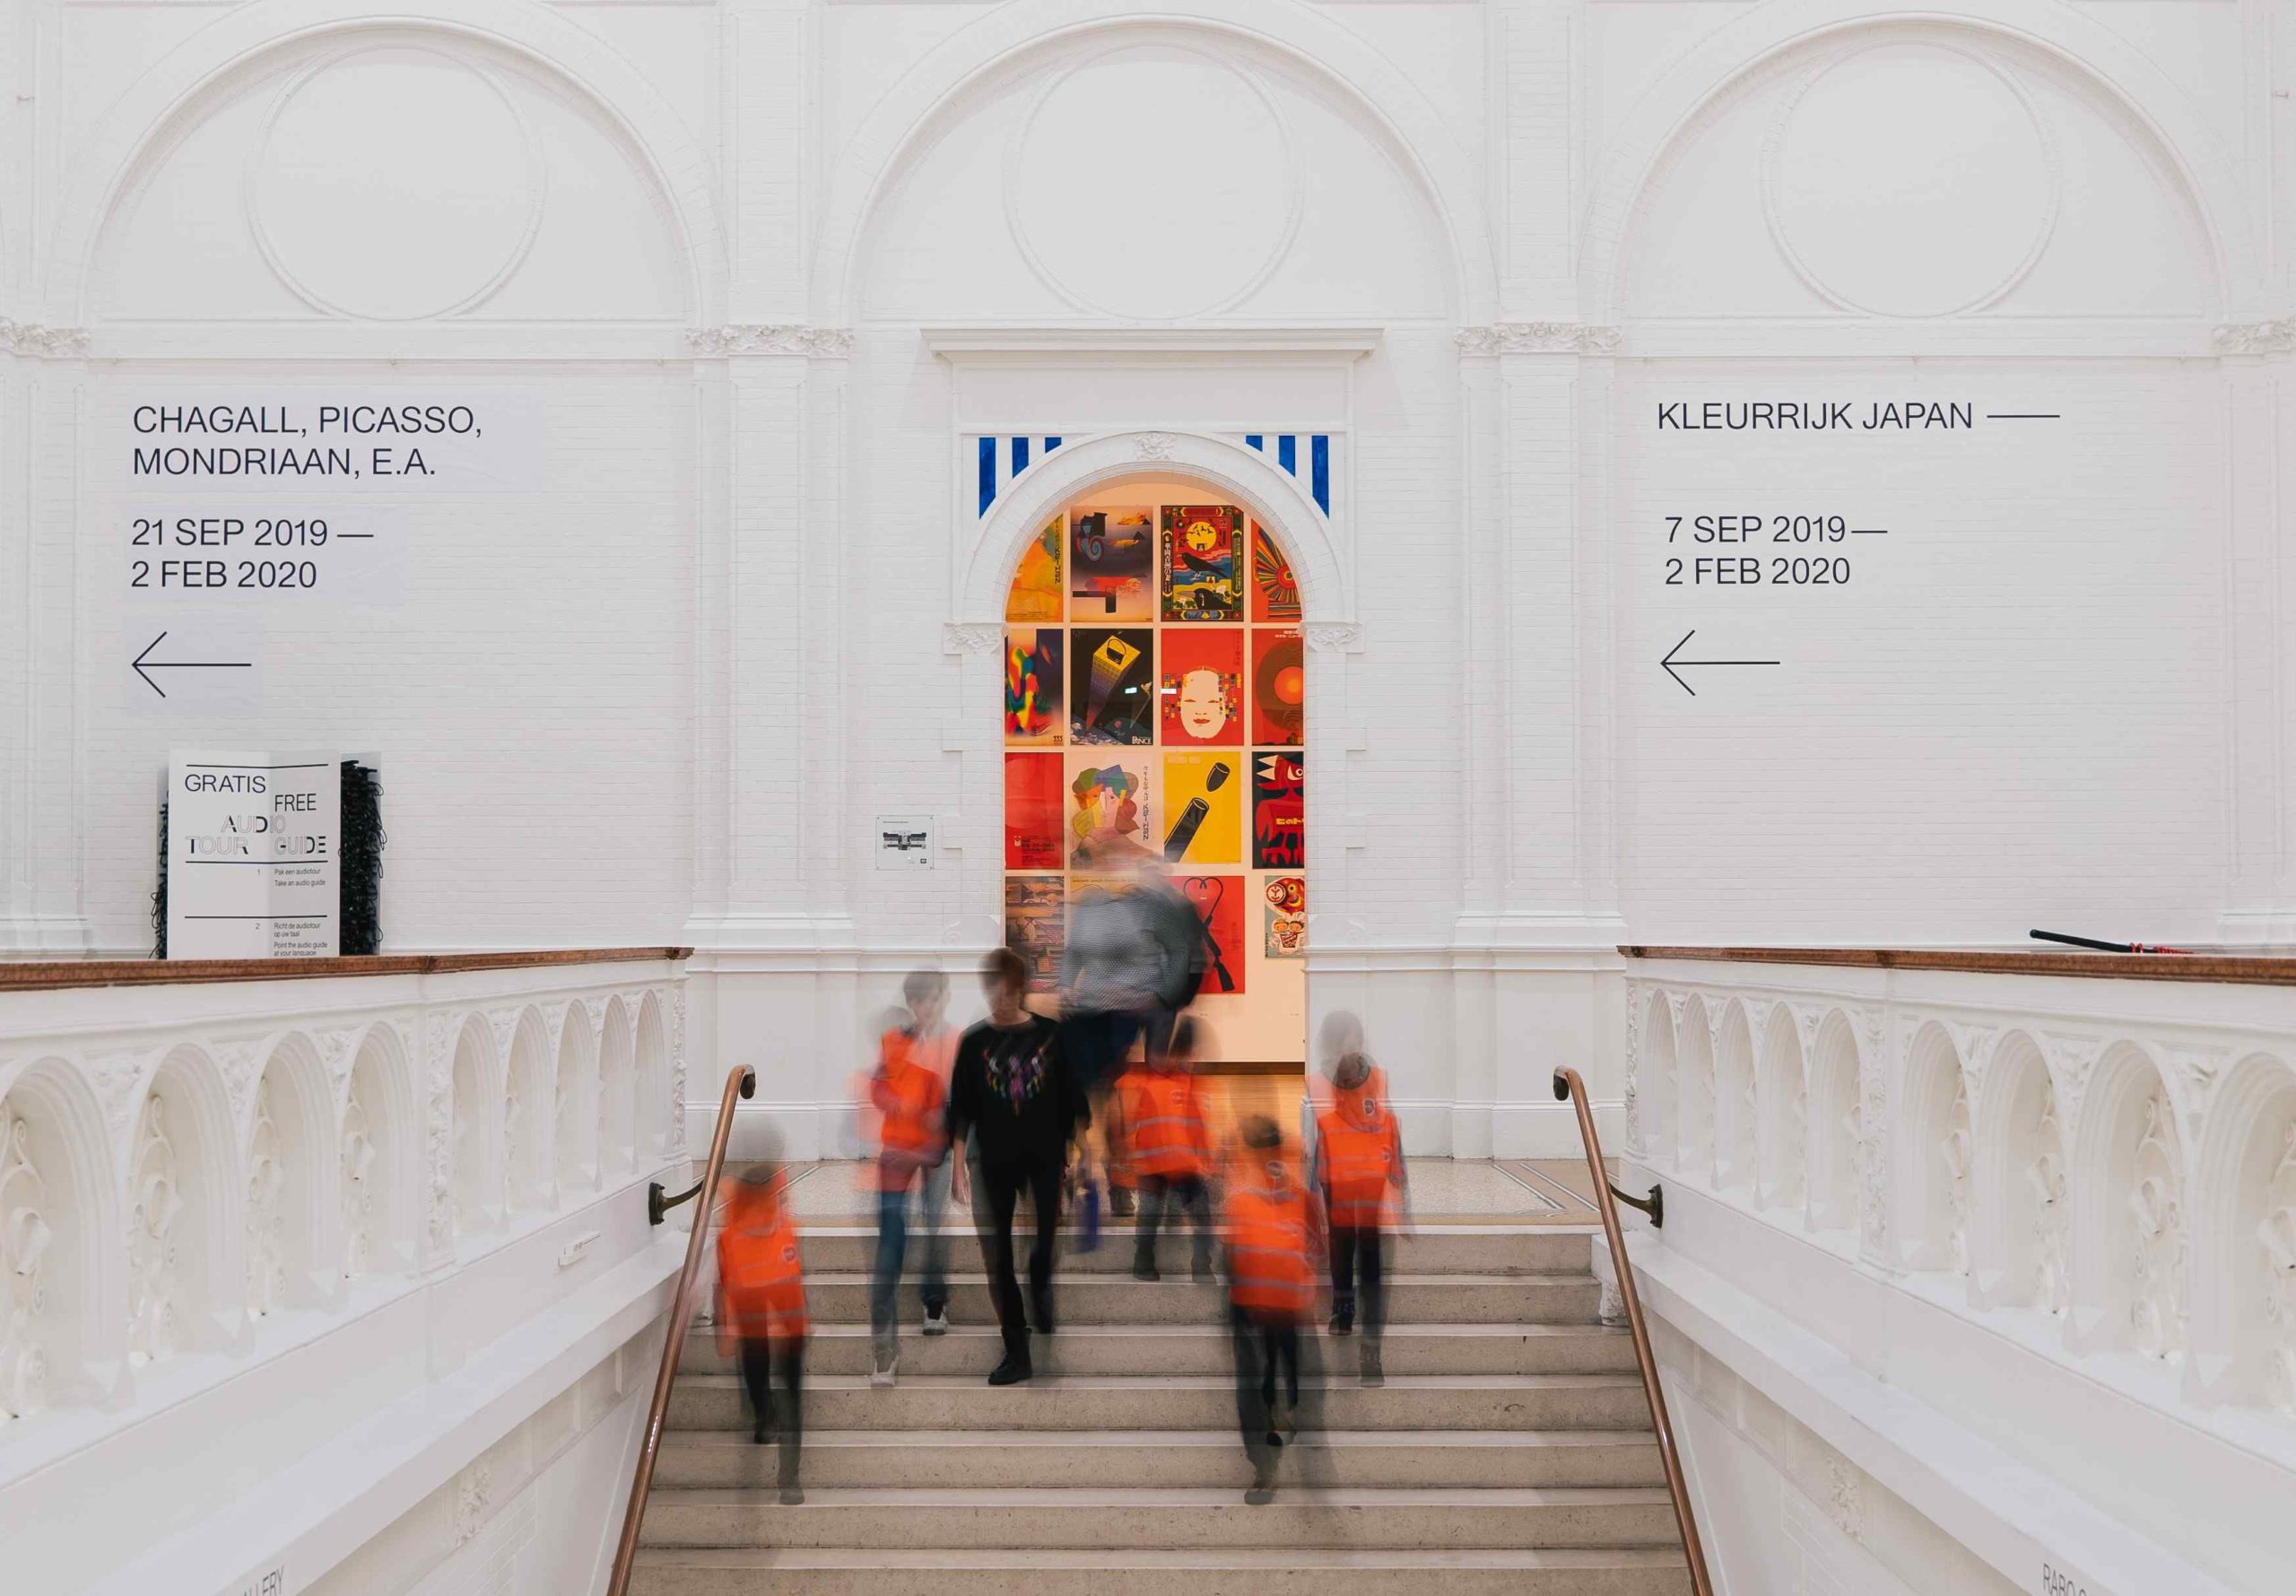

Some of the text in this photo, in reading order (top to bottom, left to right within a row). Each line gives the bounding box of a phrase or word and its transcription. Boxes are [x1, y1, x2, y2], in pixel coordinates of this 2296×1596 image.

[133, 405, 482, 438] CHAGALL, PICASSO,
[1658, 402, 1853, 430] KLEURRIJK
[1862, 402, 1972, 429] JAPAN
[134, 447, 435, 480] MONDRIAAN, E.A.
[131, 518, 164, 547] 21
[175, 518, 245, 547] SEP
[254, 518, 329, 547] 2019
[1665, 516, 1683, 543] 7
[1693, 515, 1762, 543] SEP
[131, 560, 317, 588] 2 FEB 2020
[1665, 557, 1850, 585] 2 FEB 2020
[185, 774, 266, 794] GRATIS
[274, 793, 317, 812] FREE
[221, 814, 287, 834] AUDIO
[185, 835, 326, 855] TOUR GUIDE
[296, 867, 322, 875] audiotour
[274, 880, 287, 888] Take
[310, 880, 326, 888] guide
[312, 941, 328, 950] guide
